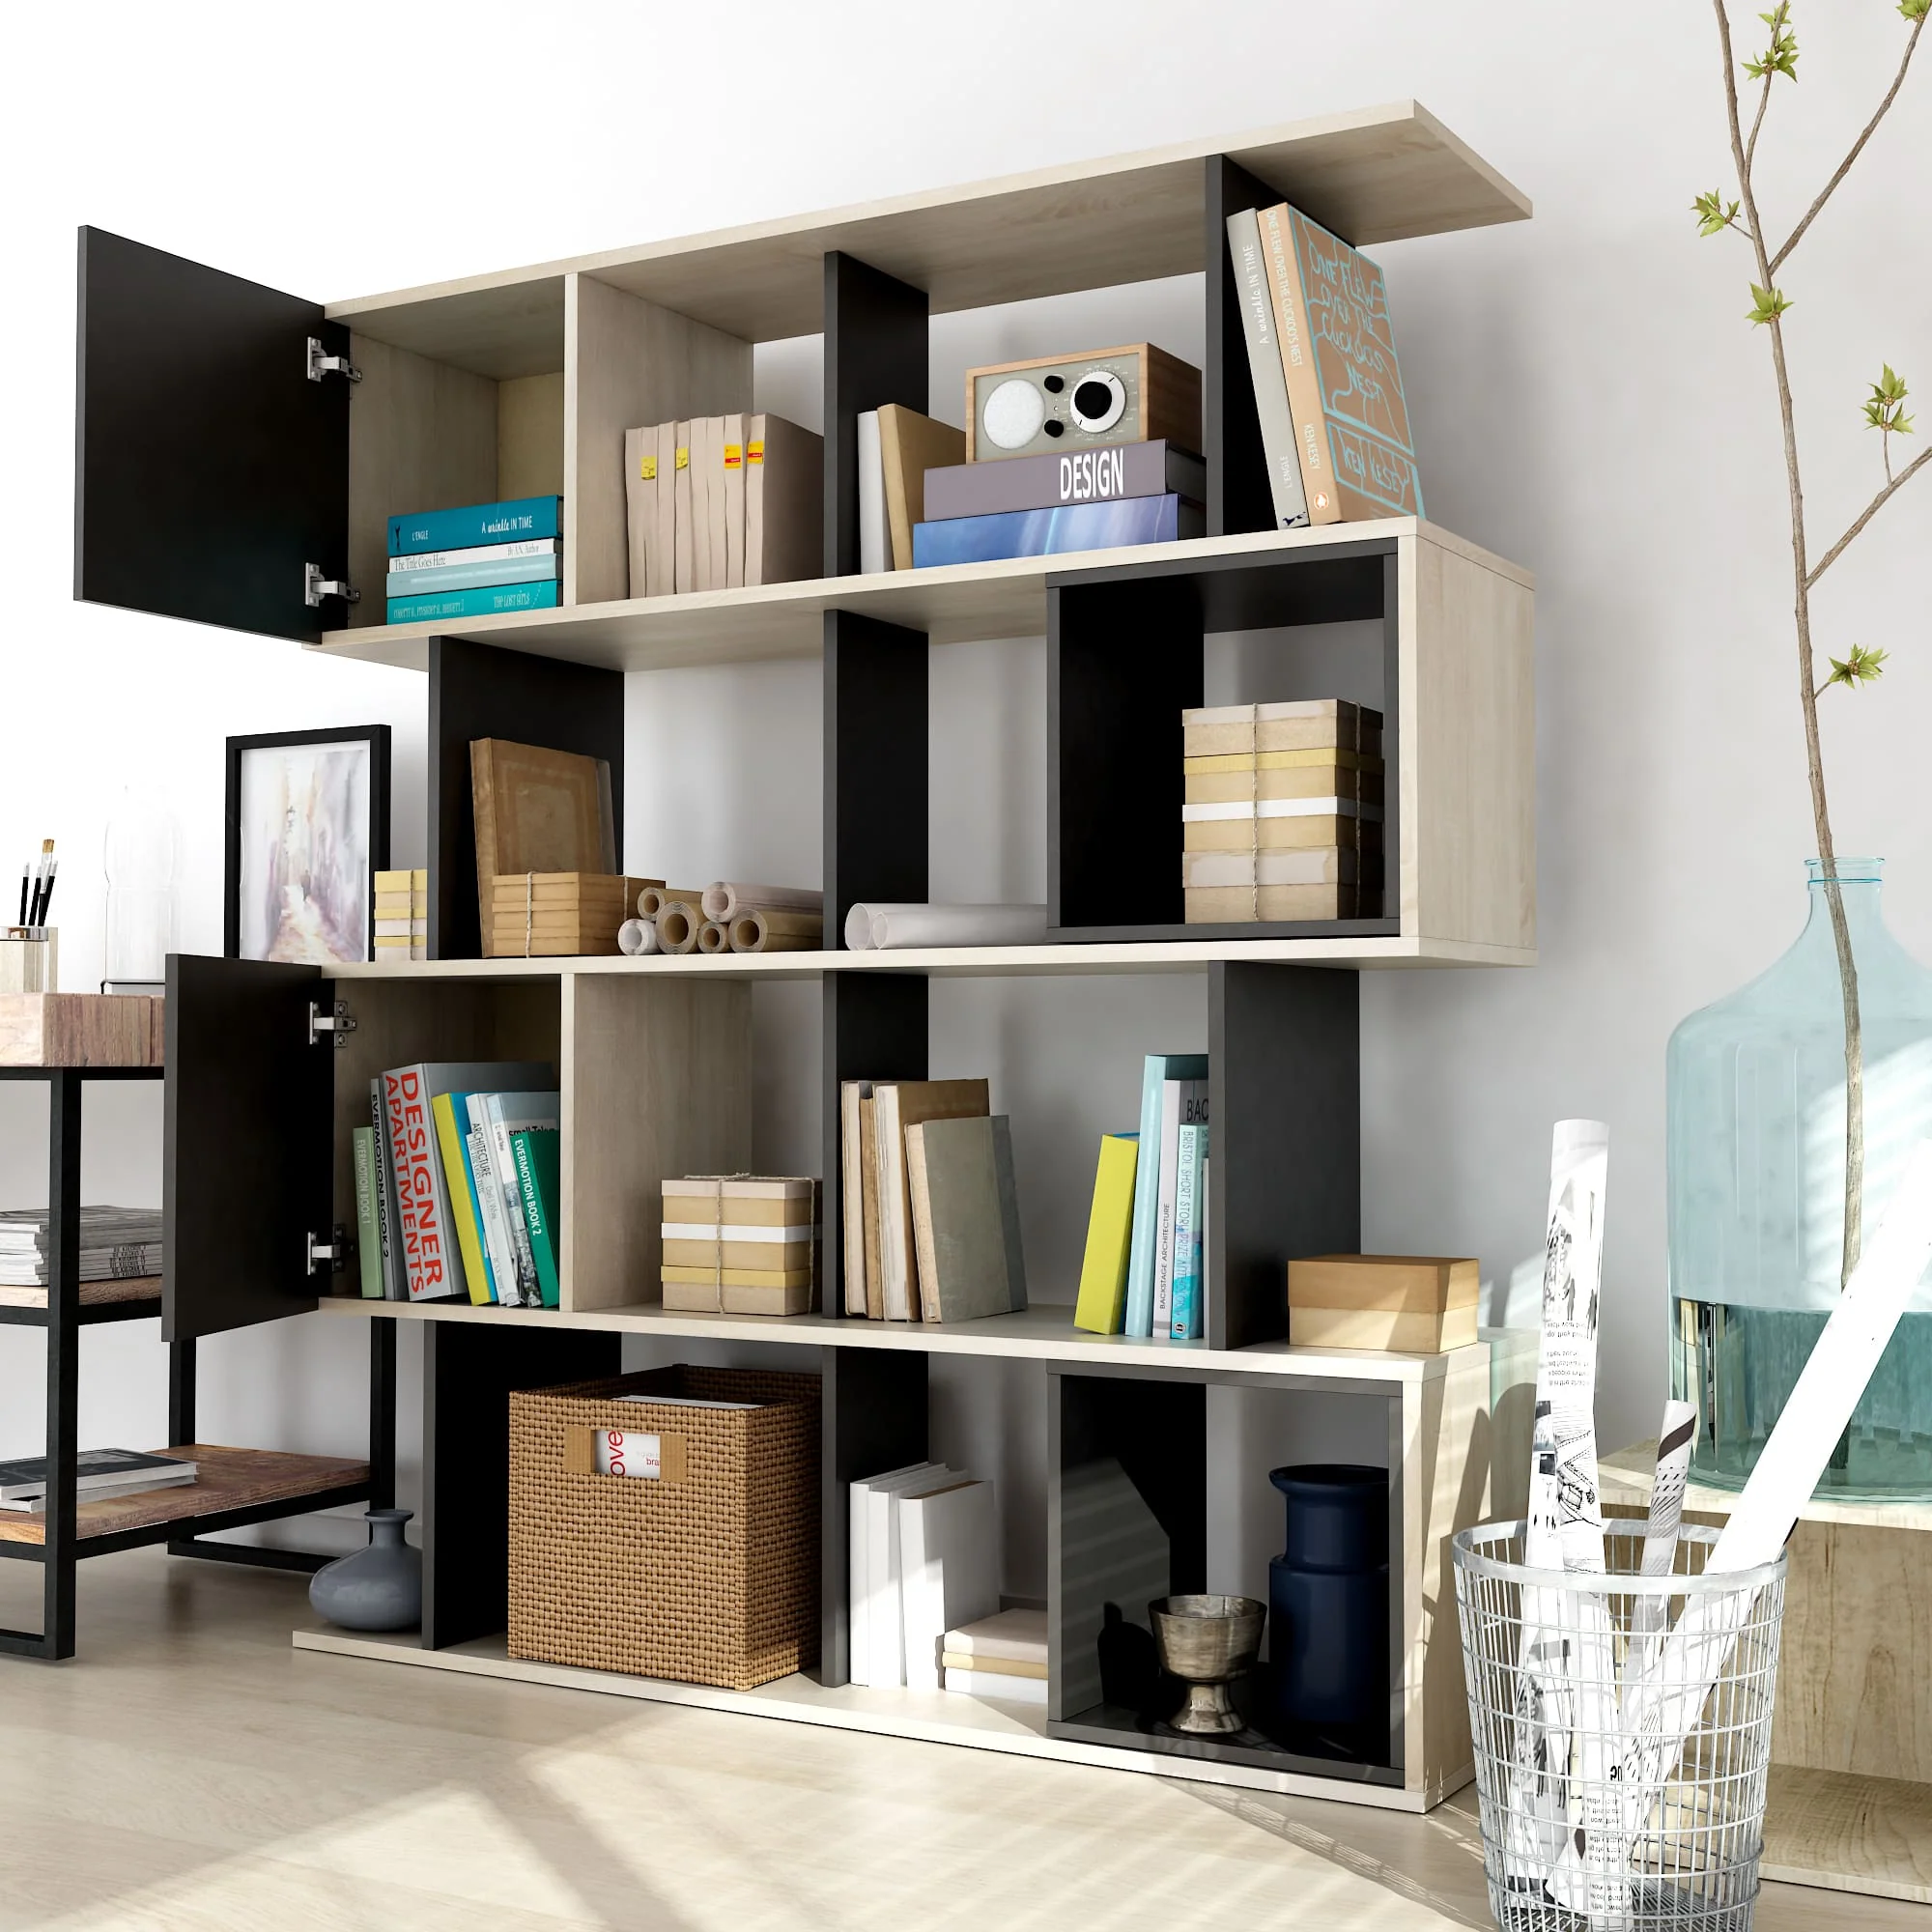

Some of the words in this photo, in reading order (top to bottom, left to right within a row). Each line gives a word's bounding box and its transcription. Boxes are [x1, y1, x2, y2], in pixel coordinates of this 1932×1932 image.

[1243, 243, 1257, 272] TIME
[1248, 273, 1258, 288] IN
[1060, 447, 1124, 500] DESIGN
[481, 522, 487, 534] A
[510, 517, 518, 530] IN
[518, 515, 533, 529] TIME
[394, 558, 405, 572] The
[356, 1139, 369, 1192] EVERMOTION
[471, 1122, 492, 1178] ARCHITECTURE
[1181, 1130, 1194, 1167] BRISTOL
[371, 1094, 384, 1195] EVERMOTION
[378, 1197, 388, 1244] BOOK
[385, 1075, 425, 1294] APARTMENTS
[400, 1072, 442, 1285] DESIGNER
[514, 1138, 535, 1201] EVERMOTION
[1180, 1171, 1192, 1200] SHORT
[362, 1194, 371, 1218] BOOK
[526, 1202, 541, 1228] BOOK
[532, 1228, 542, 1236] 2
[1161, 1204, 1171, 1261] ARCHITECTURE
[1178, 1232, 1190, 1257] PRIZE
[1159, 1264, 1169, 1310] BACKSTAGE
